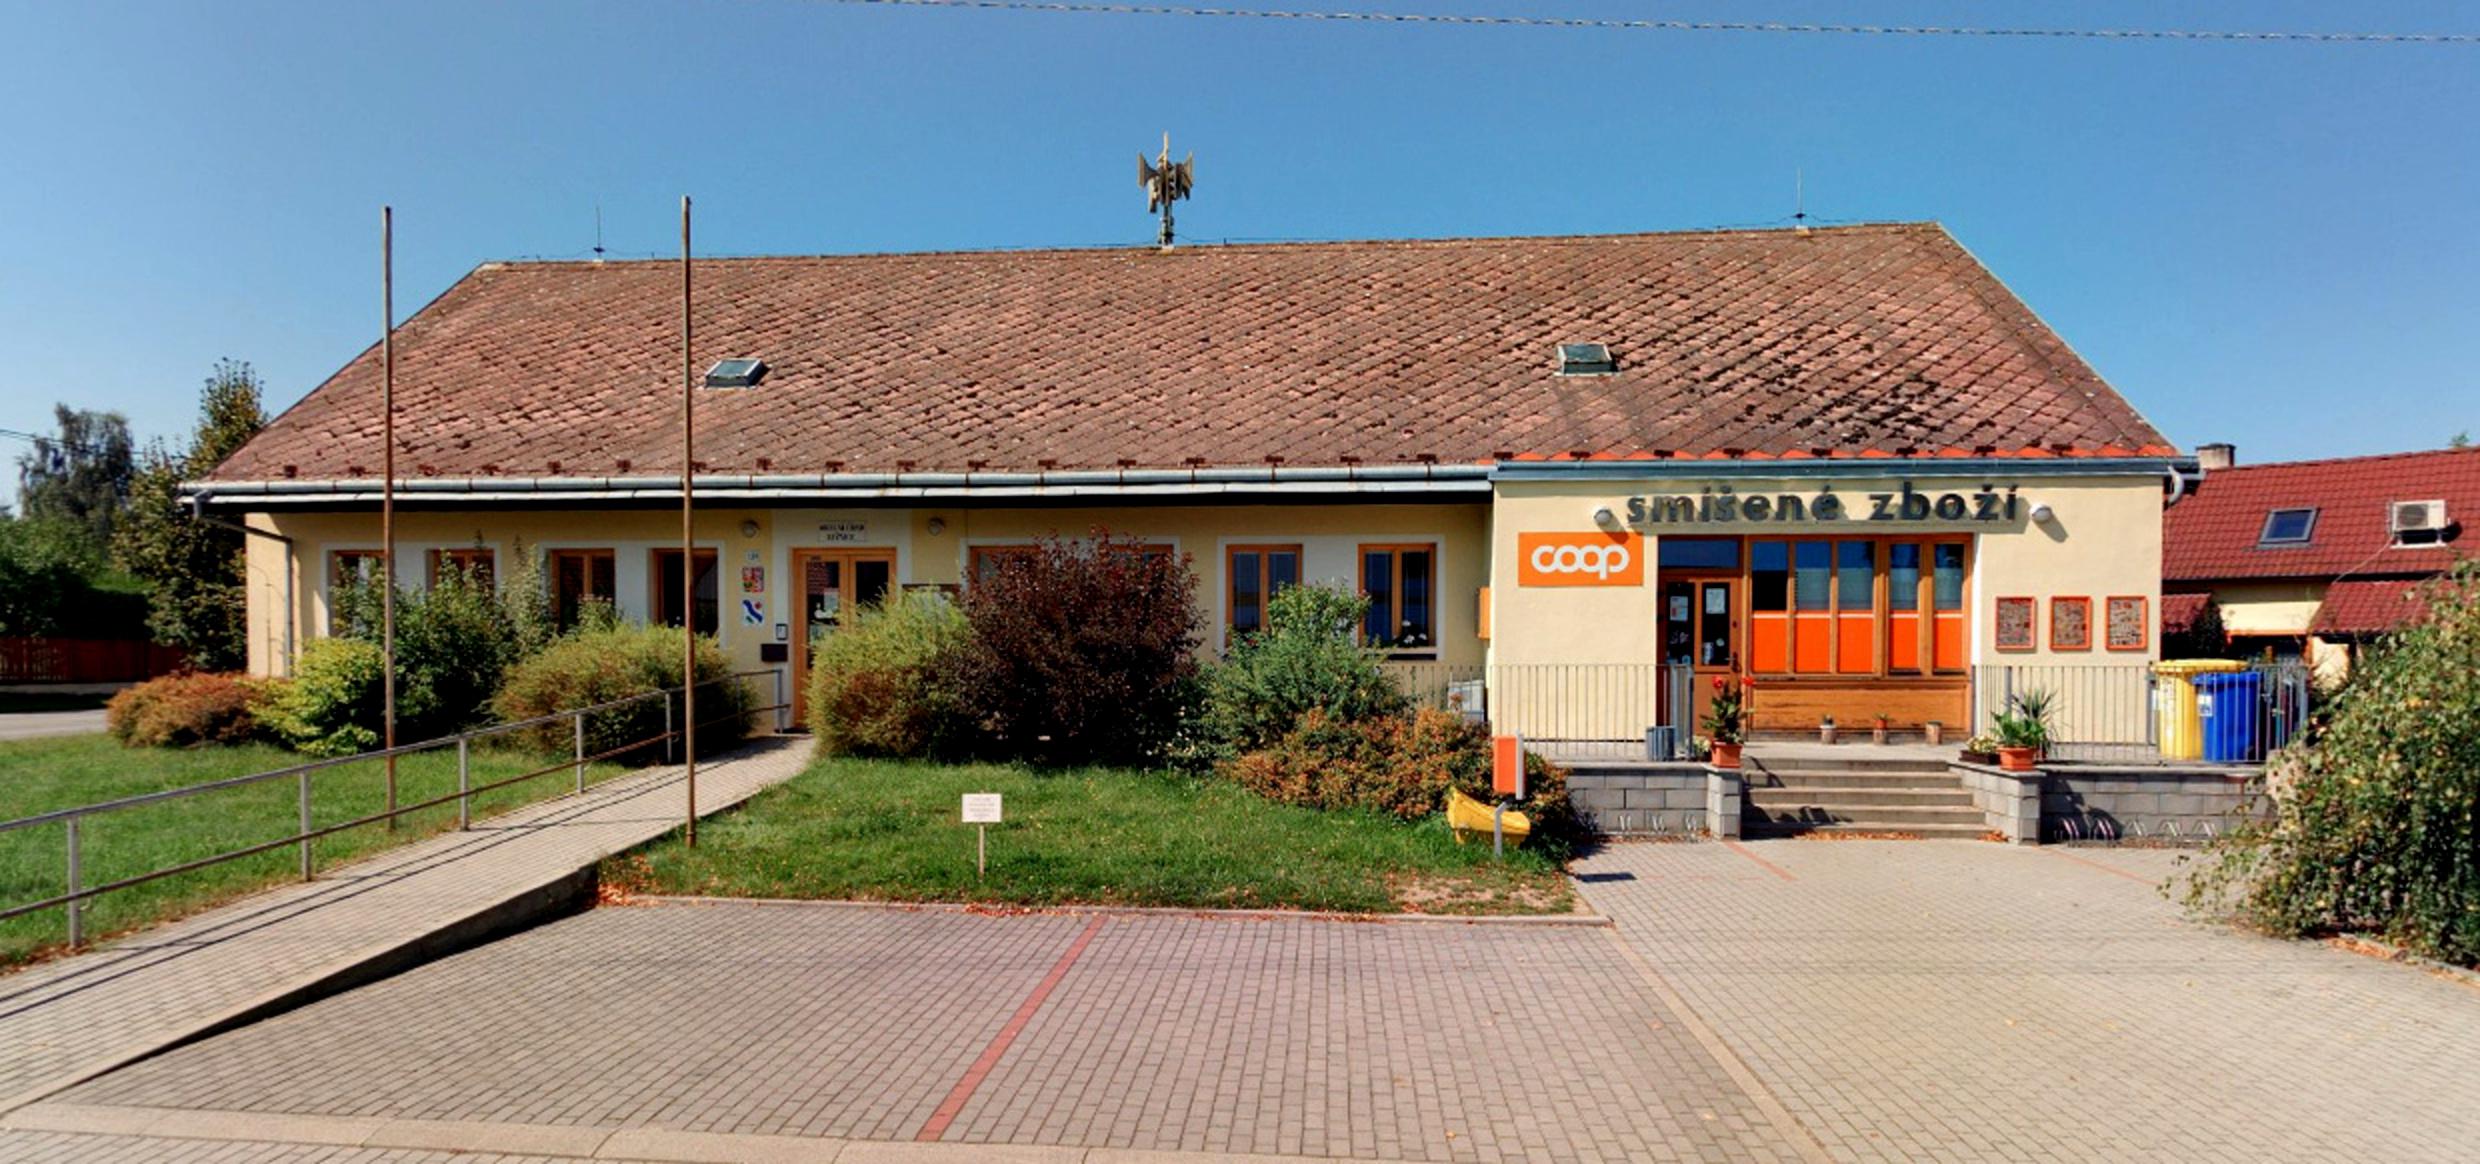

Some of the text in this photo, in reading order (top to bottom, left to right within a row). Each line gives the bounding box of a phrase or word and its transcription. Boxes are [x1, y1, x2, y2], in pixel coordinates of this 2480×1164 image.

[1627, 481, 2019, 522] smíšené zboží
[1531, 544, 1630, 580] coop
